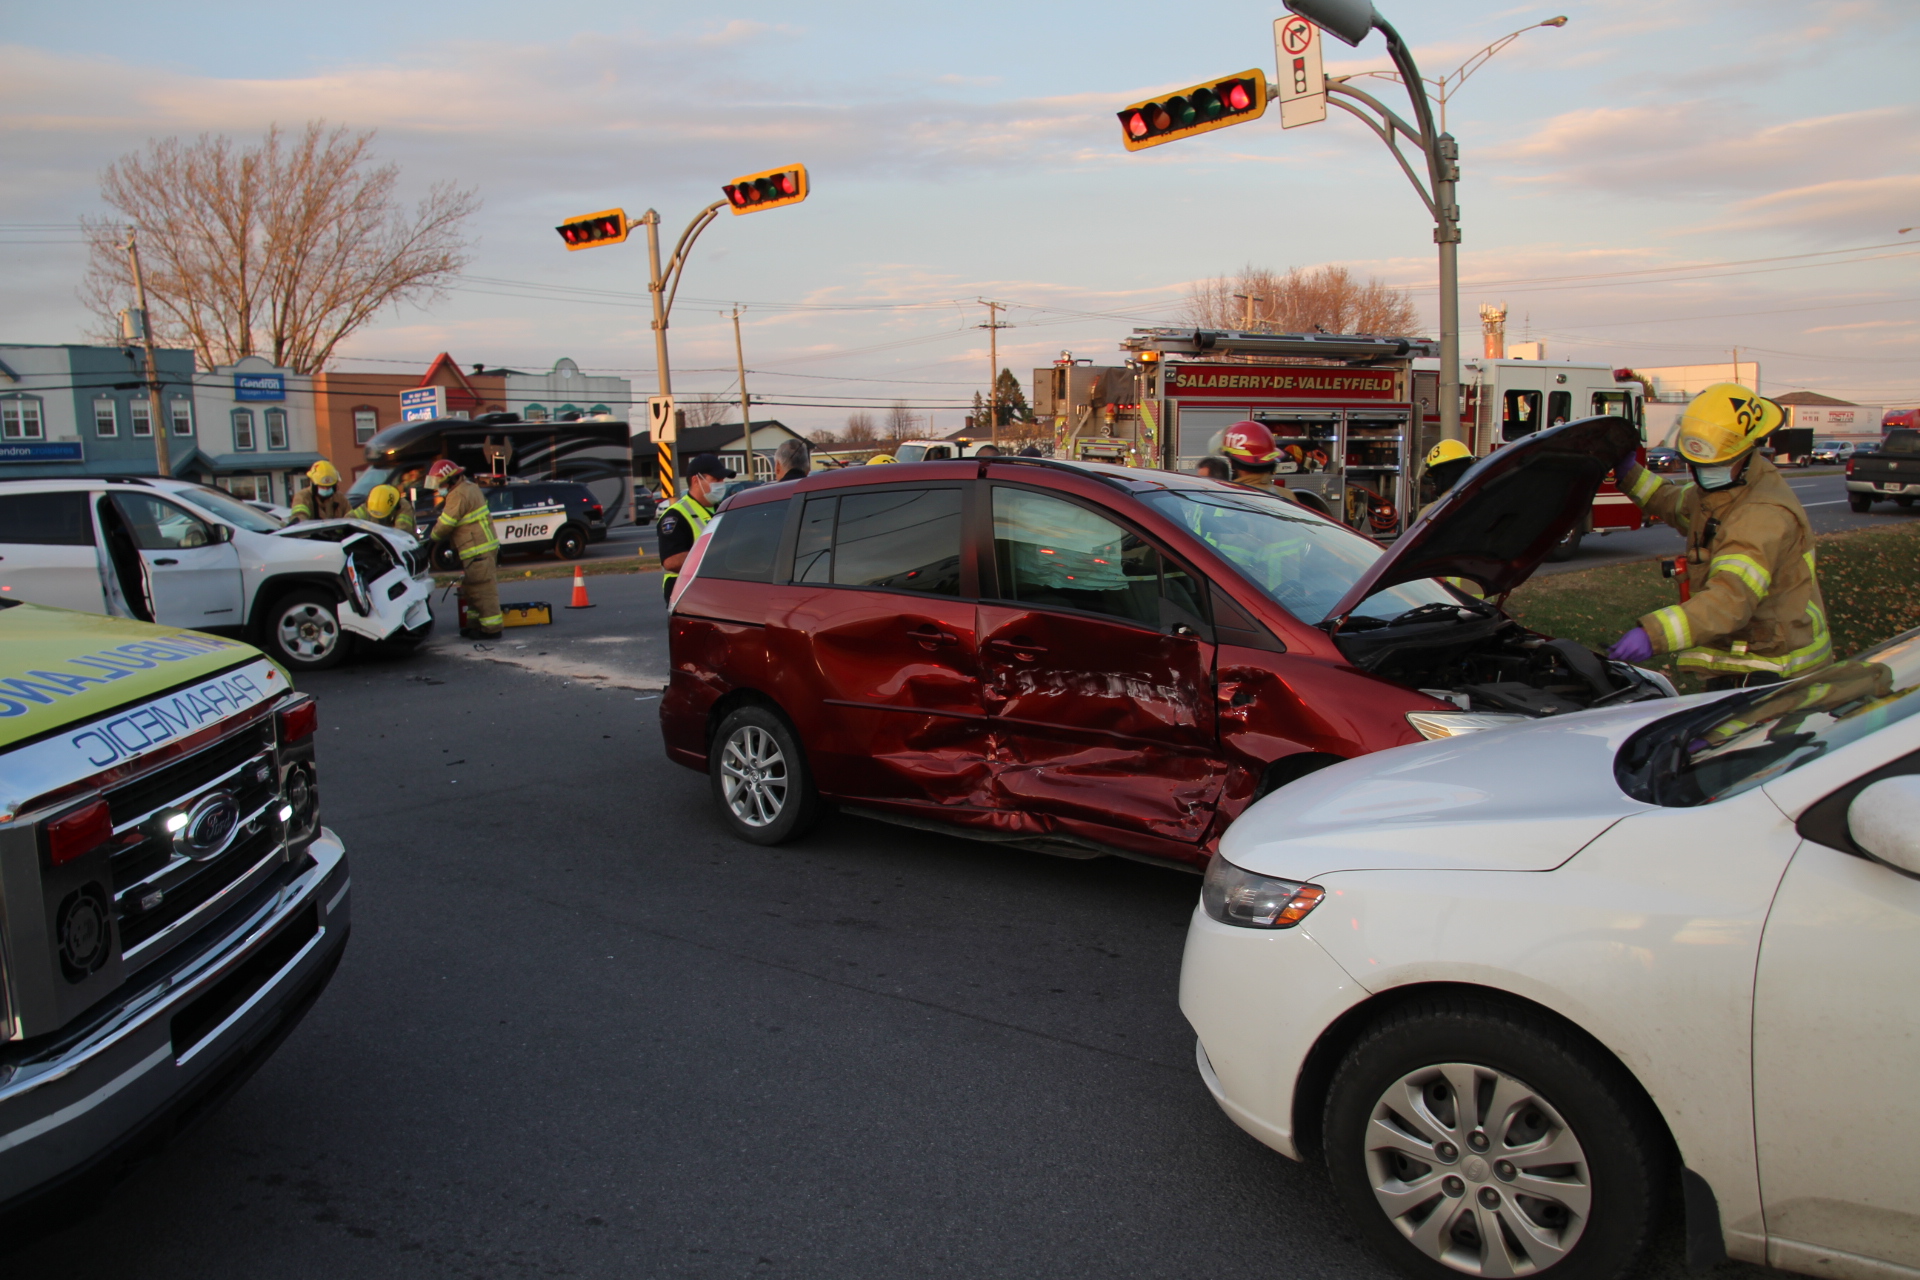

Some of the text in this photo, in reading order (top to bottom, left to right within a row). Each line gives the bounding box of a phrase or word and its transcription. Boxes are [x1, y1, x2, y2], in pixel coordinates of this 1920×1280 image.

[240, 377, 280, 390] Gendron
[1176, 373, 1392, 391] SALABERRY-DE-VALLEYFIELD
[1737, 397, 1763, 437] 25
[1225, 432, 1248, 450] 112
[0, 447, 30, 456] endron
[438, 463, 453, 477] 111
[505, 523, 548, 539] Police
[205, 809, 232, 840] Ford
